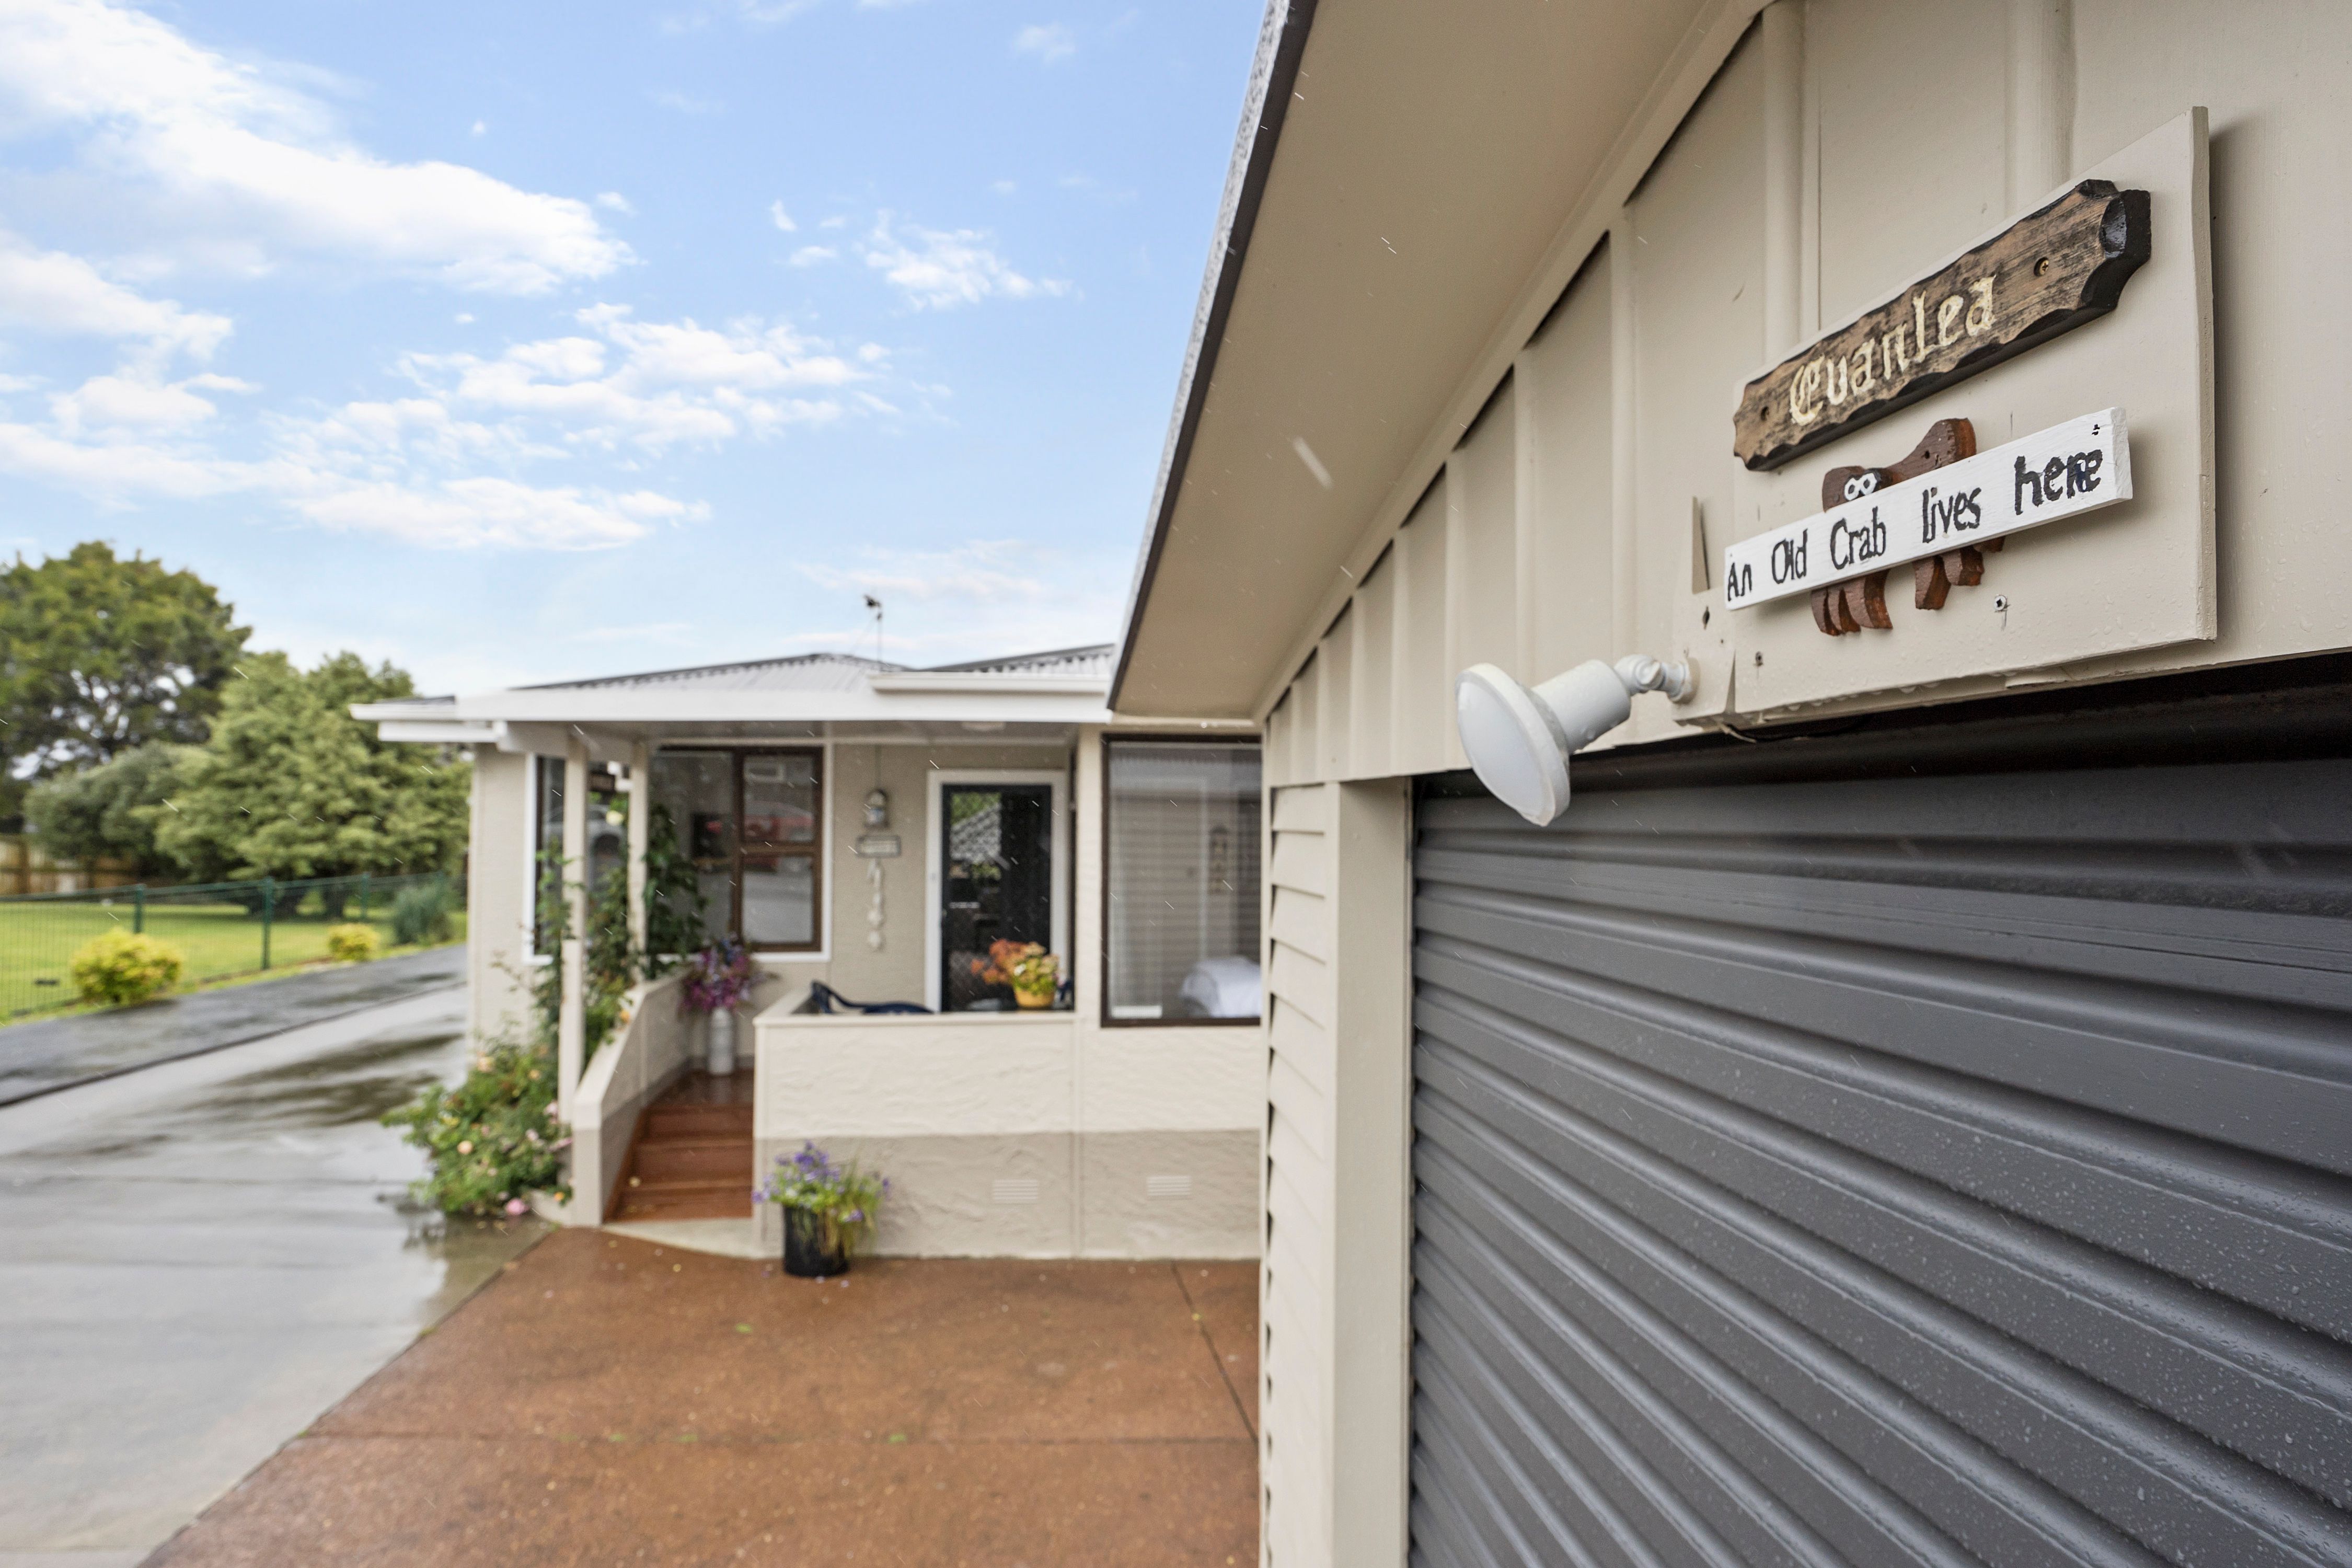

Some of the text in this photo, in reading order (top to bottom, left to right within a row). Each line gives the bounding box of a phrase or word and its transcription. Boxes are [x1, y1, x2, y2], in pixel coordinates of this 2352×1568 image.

[1727, 449, 2103, 601] An Old Crab lives here
